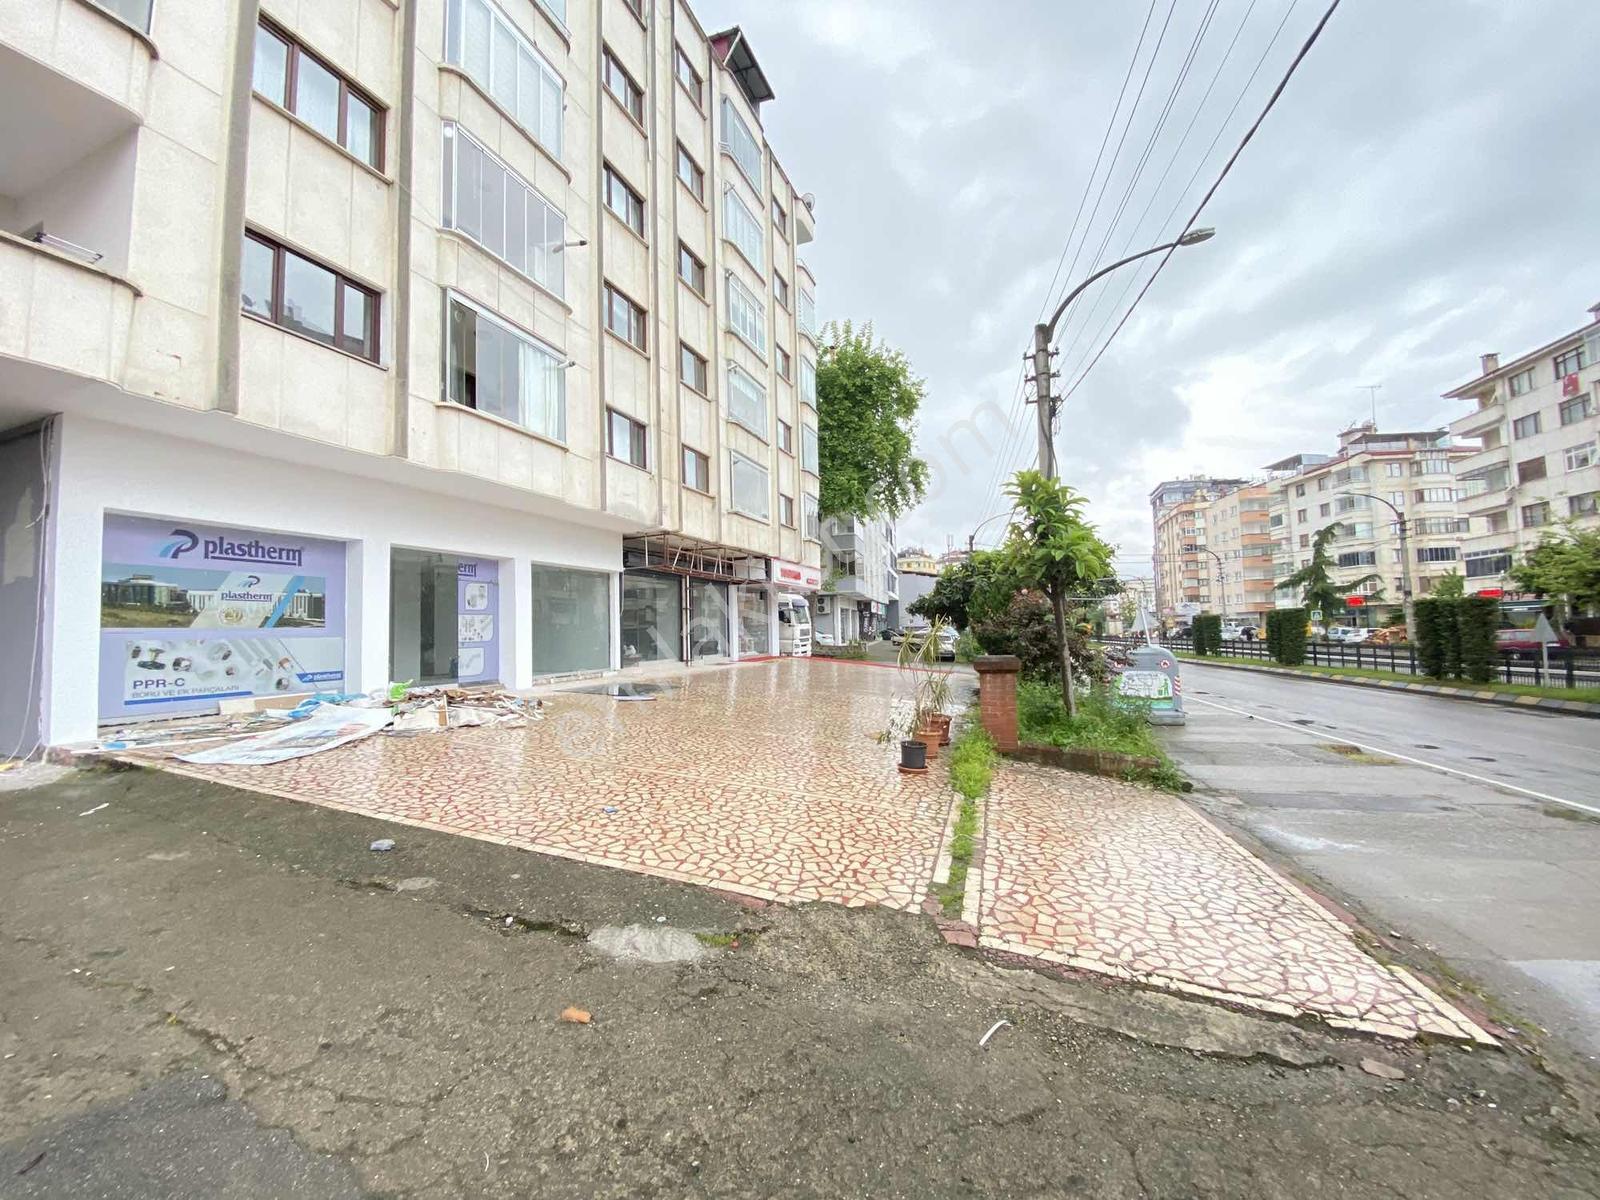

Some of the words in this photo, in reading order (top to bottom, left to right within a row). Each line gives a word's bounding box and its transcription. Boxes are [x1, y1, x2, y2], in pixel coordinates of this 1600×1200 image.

[204, 536, 302, 566] plastherm
[221, 591, 273, 602] plastherm
[133, 678, 185, 690] PPR-C
